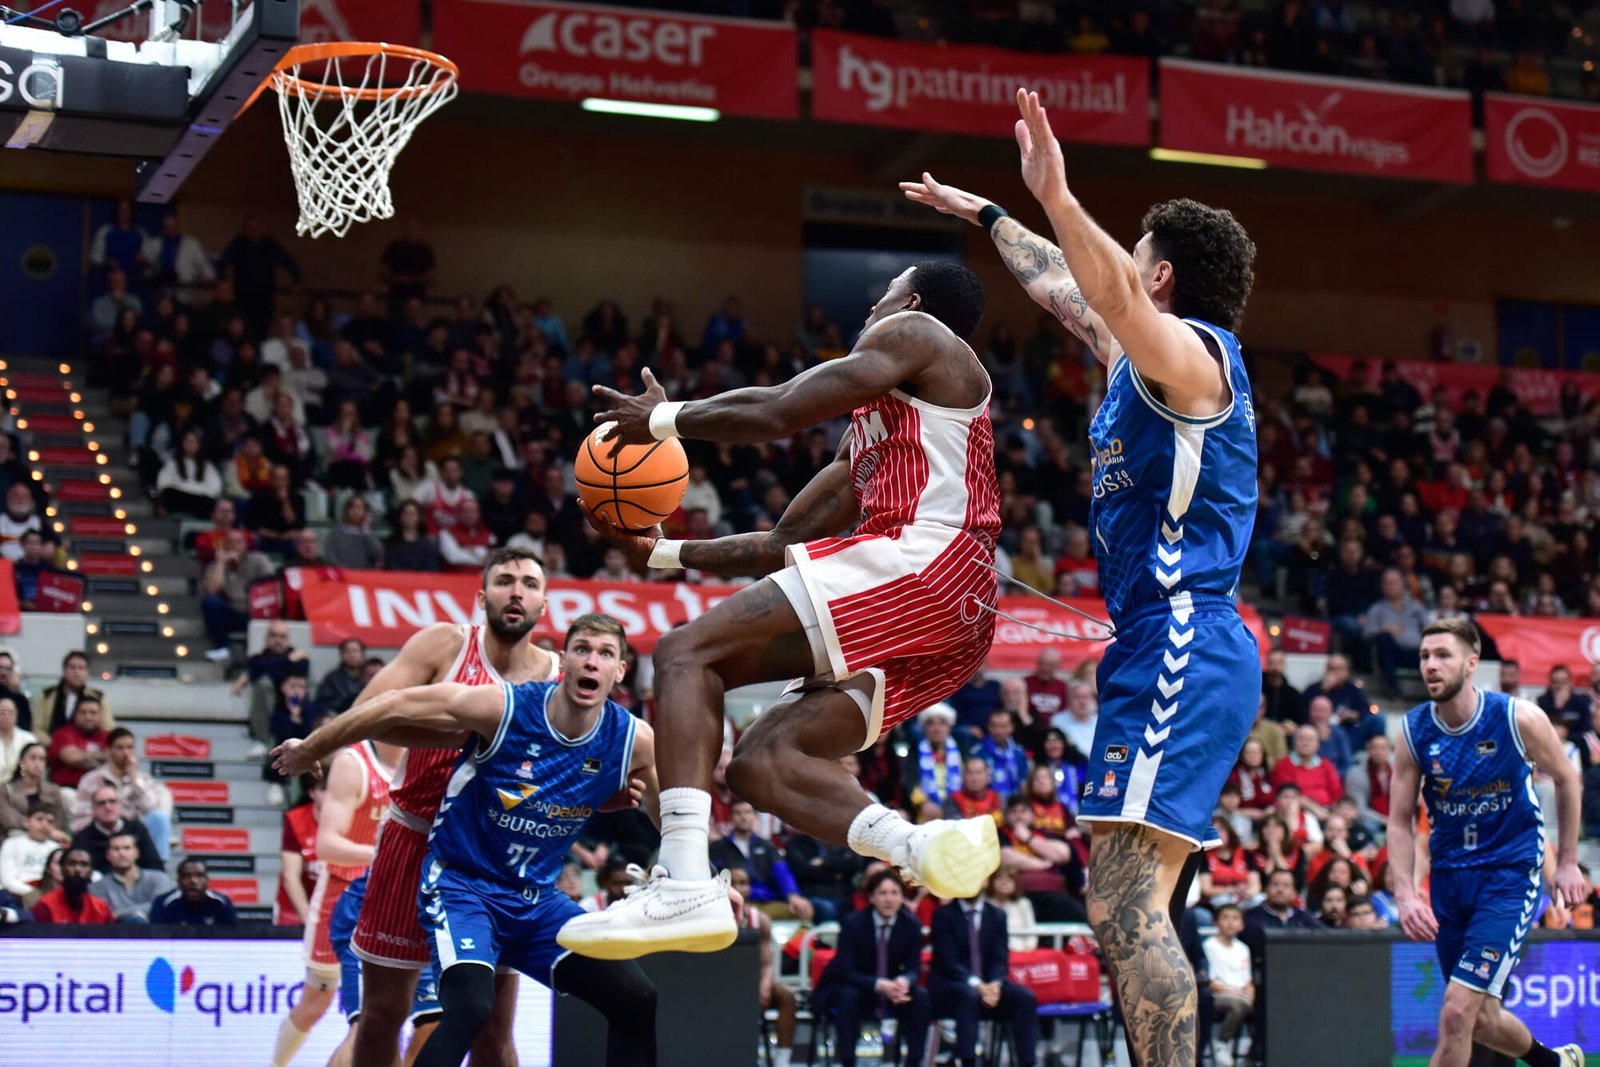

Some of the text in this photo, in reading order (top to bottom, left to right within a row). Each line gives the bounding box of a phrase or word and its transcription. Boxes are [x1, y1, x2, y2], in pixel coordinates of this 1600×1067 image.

[559, 14, 716, 67] caser
[518, 62, 717, 101] Grupo Helvetia
[497, 813, 571, 839] BURGOS
[1463, 823, 1478, 850] 6
[506, 843, 540, 878] 77
